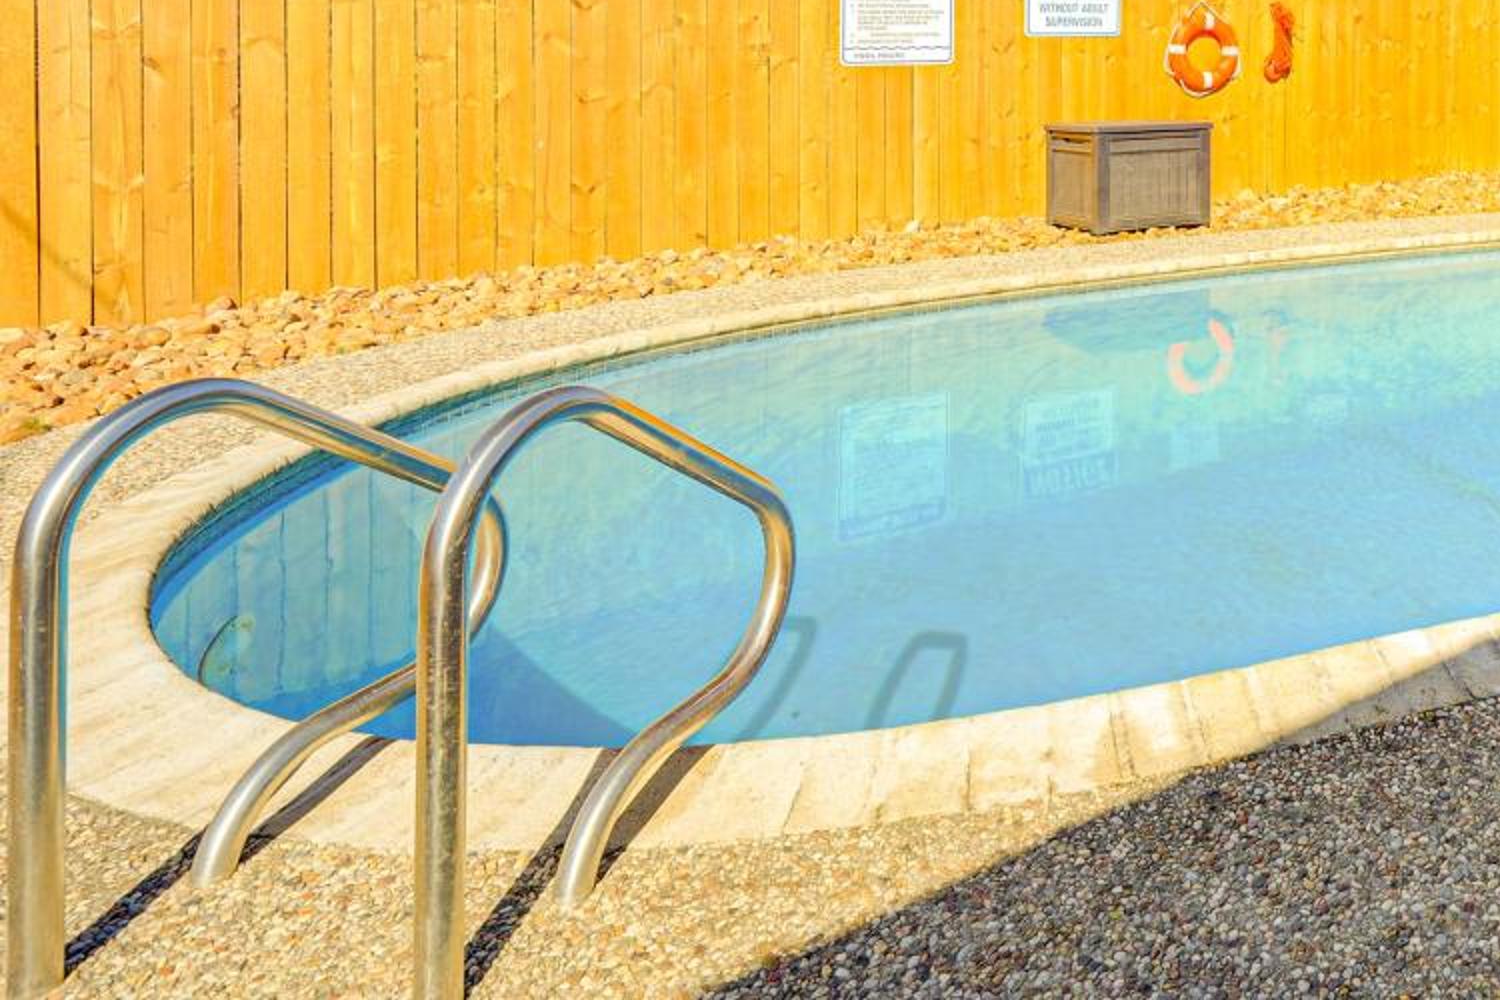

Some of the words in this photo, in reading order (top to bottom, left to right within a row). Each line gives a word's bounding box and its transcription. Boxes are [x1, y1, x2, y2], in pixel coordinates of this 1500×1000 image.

[1039, 3, 1078, 14] WITHOUT
[1081, 3, 1109, 14] ADULT
[1045, 16, 1103, 27] SUPERVISION
